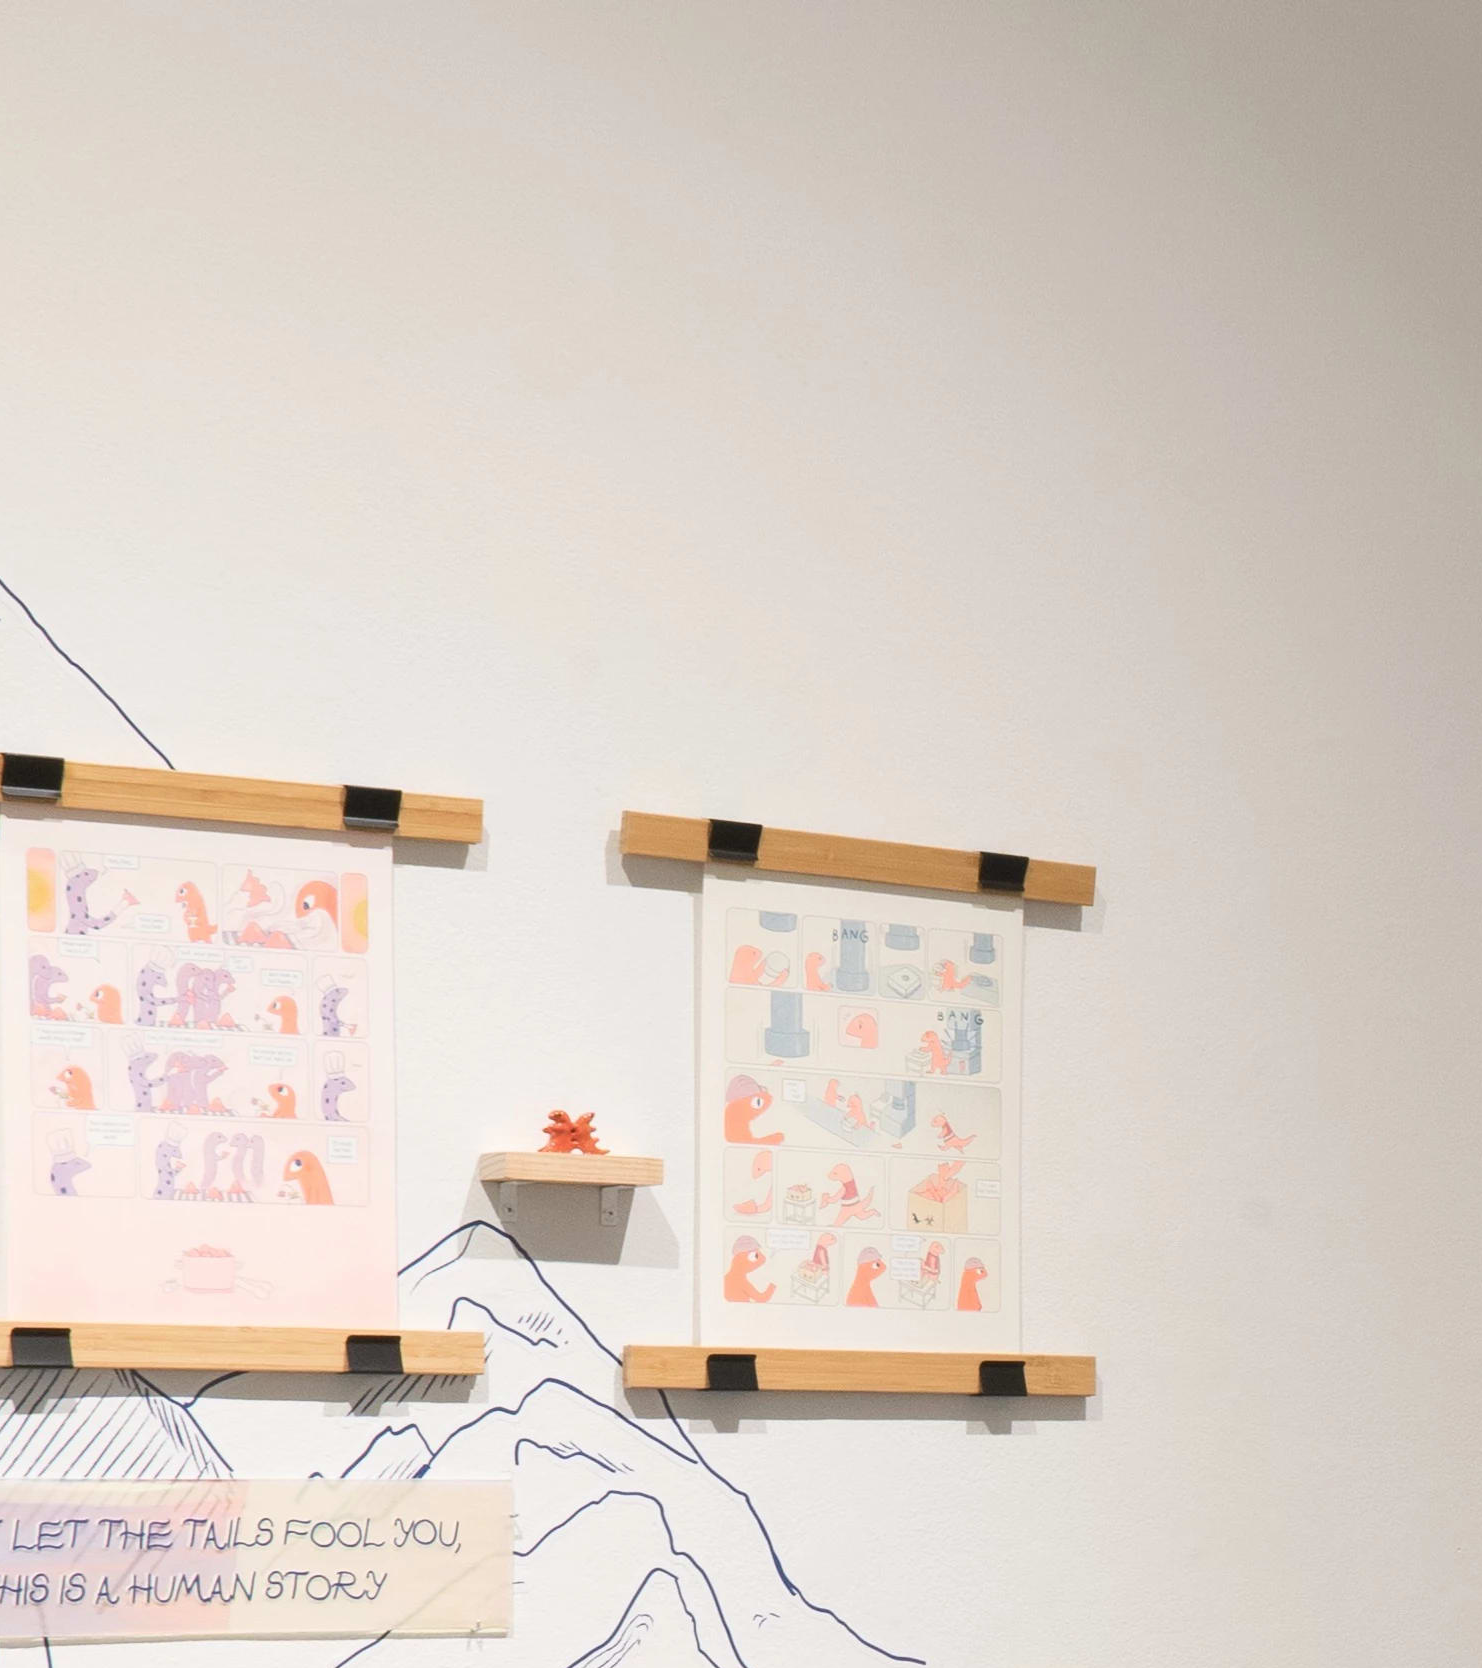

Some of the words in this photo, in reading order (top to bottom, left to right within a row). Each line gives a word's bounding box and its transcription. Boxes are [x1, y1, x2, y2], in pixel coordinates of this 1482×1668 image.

[832, 928, 870, 944] BANG
[937, 1009, 985, 1026] BANG
[12, 1518, 89, 1551] LET
[98, 1518, 173, 1551] THE
[183, 1517, 275, 1551] TAILS
[283, 1518, 386, 1548] FOOL
[393, 1517, 462, 1554] YOU,
[59, 1572, 87, 1605] IS
[95, 1576, 119, 1605] A
[127, 1571, 256, 1605] HUMAN
[265, 1570, 388, 1601] STORY
